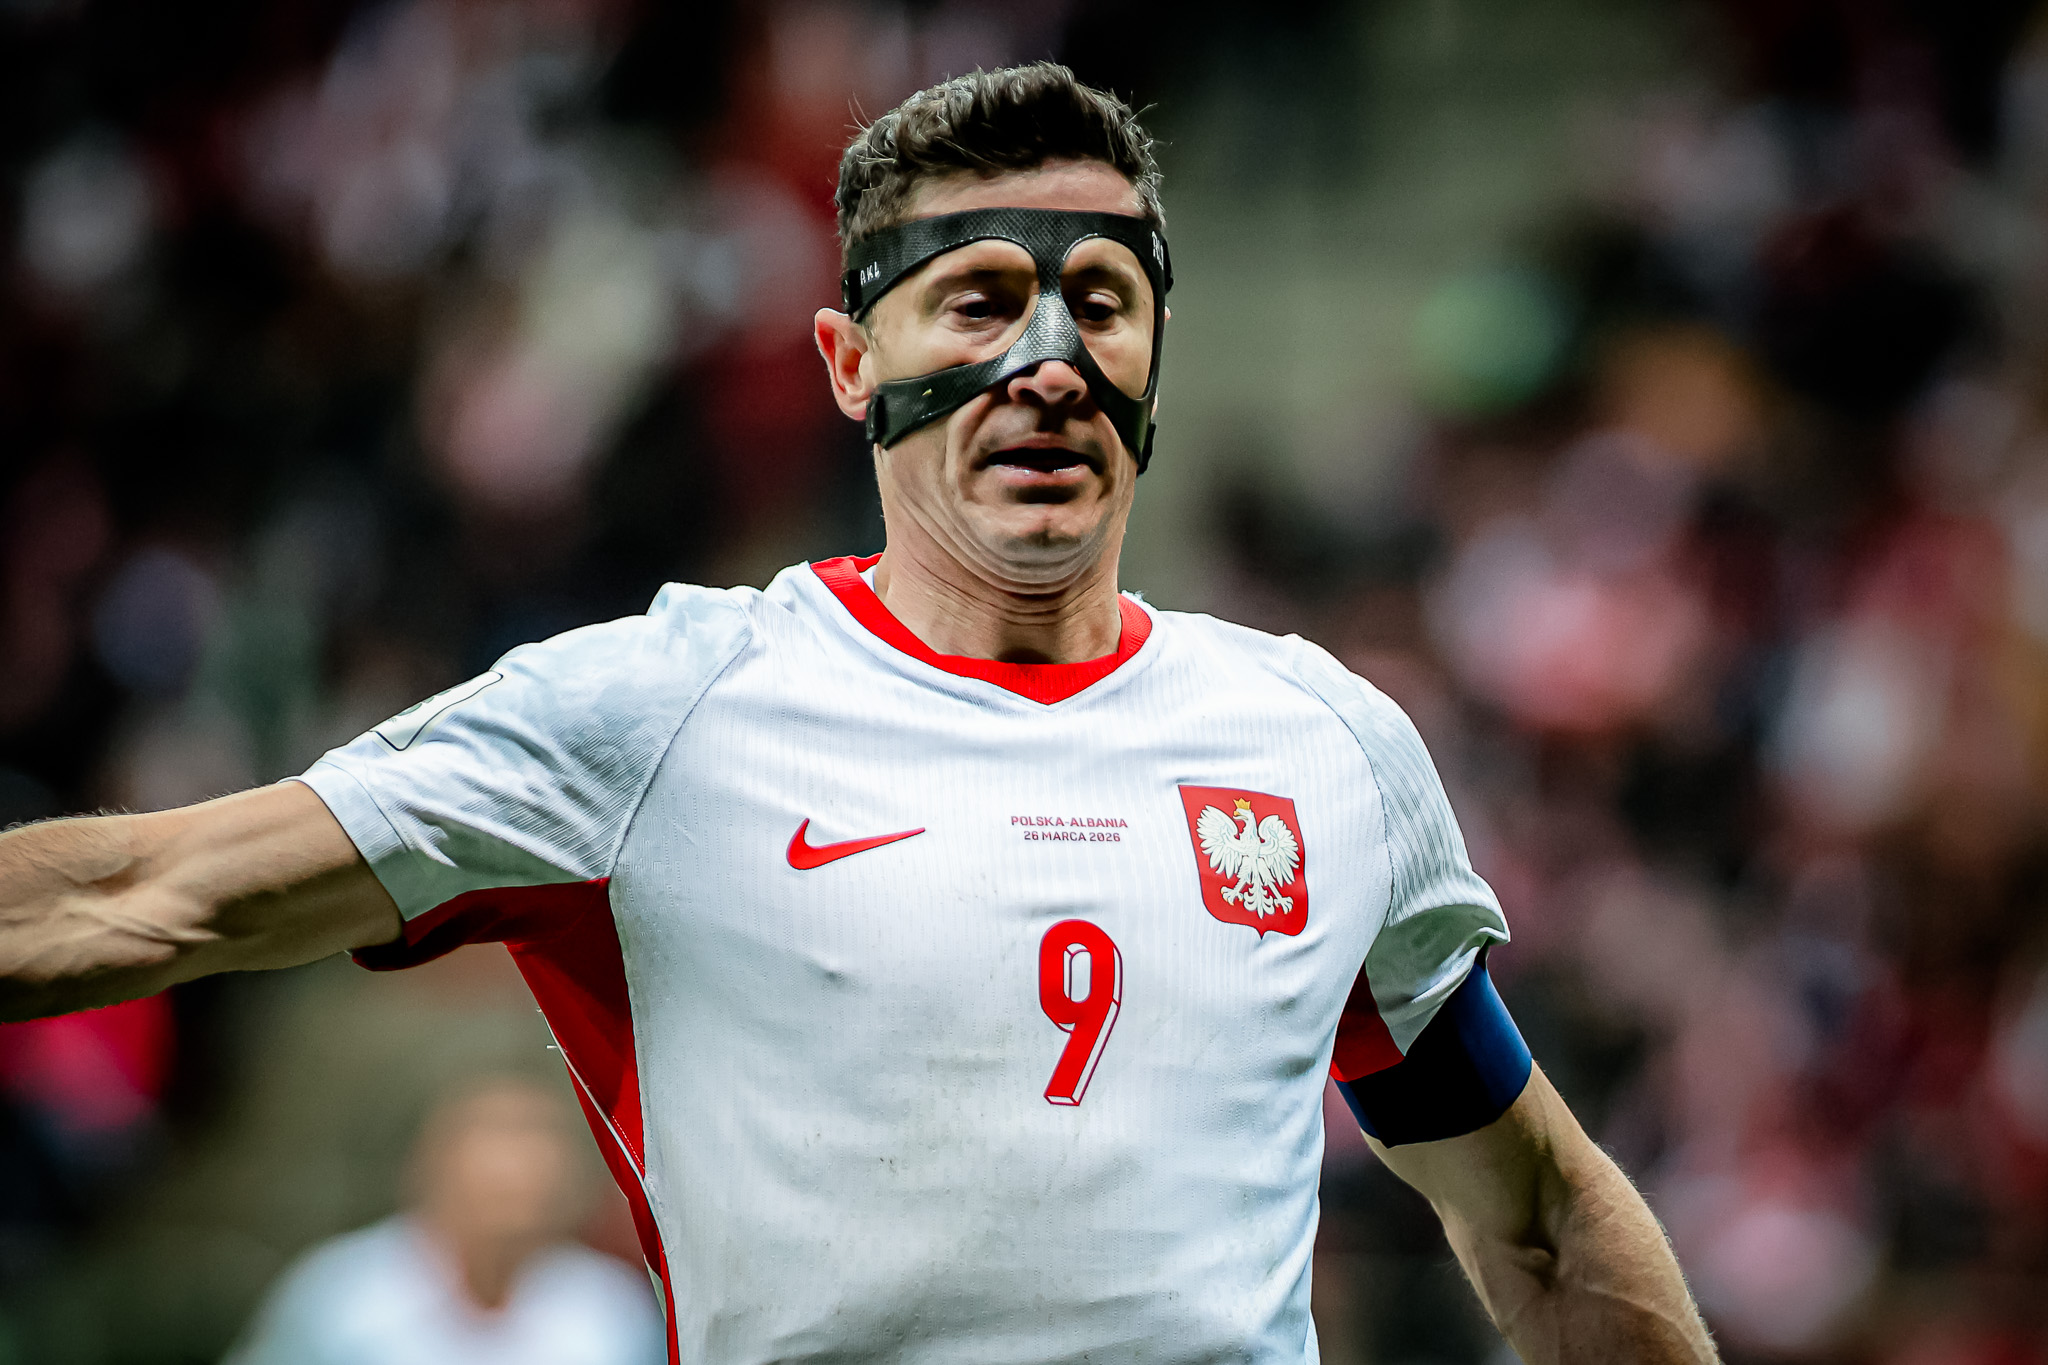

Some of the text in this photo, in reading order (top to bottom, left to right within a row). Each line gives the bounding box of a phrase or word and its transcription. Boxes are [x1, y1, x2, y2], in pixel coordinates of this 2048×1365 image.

[1010, 815, 1128, 829] POLSKA-ALBANIA
[1023, 830, 1121, 842] 26 MARCA 2026
[1039, 918, 1123, 1106] 9
